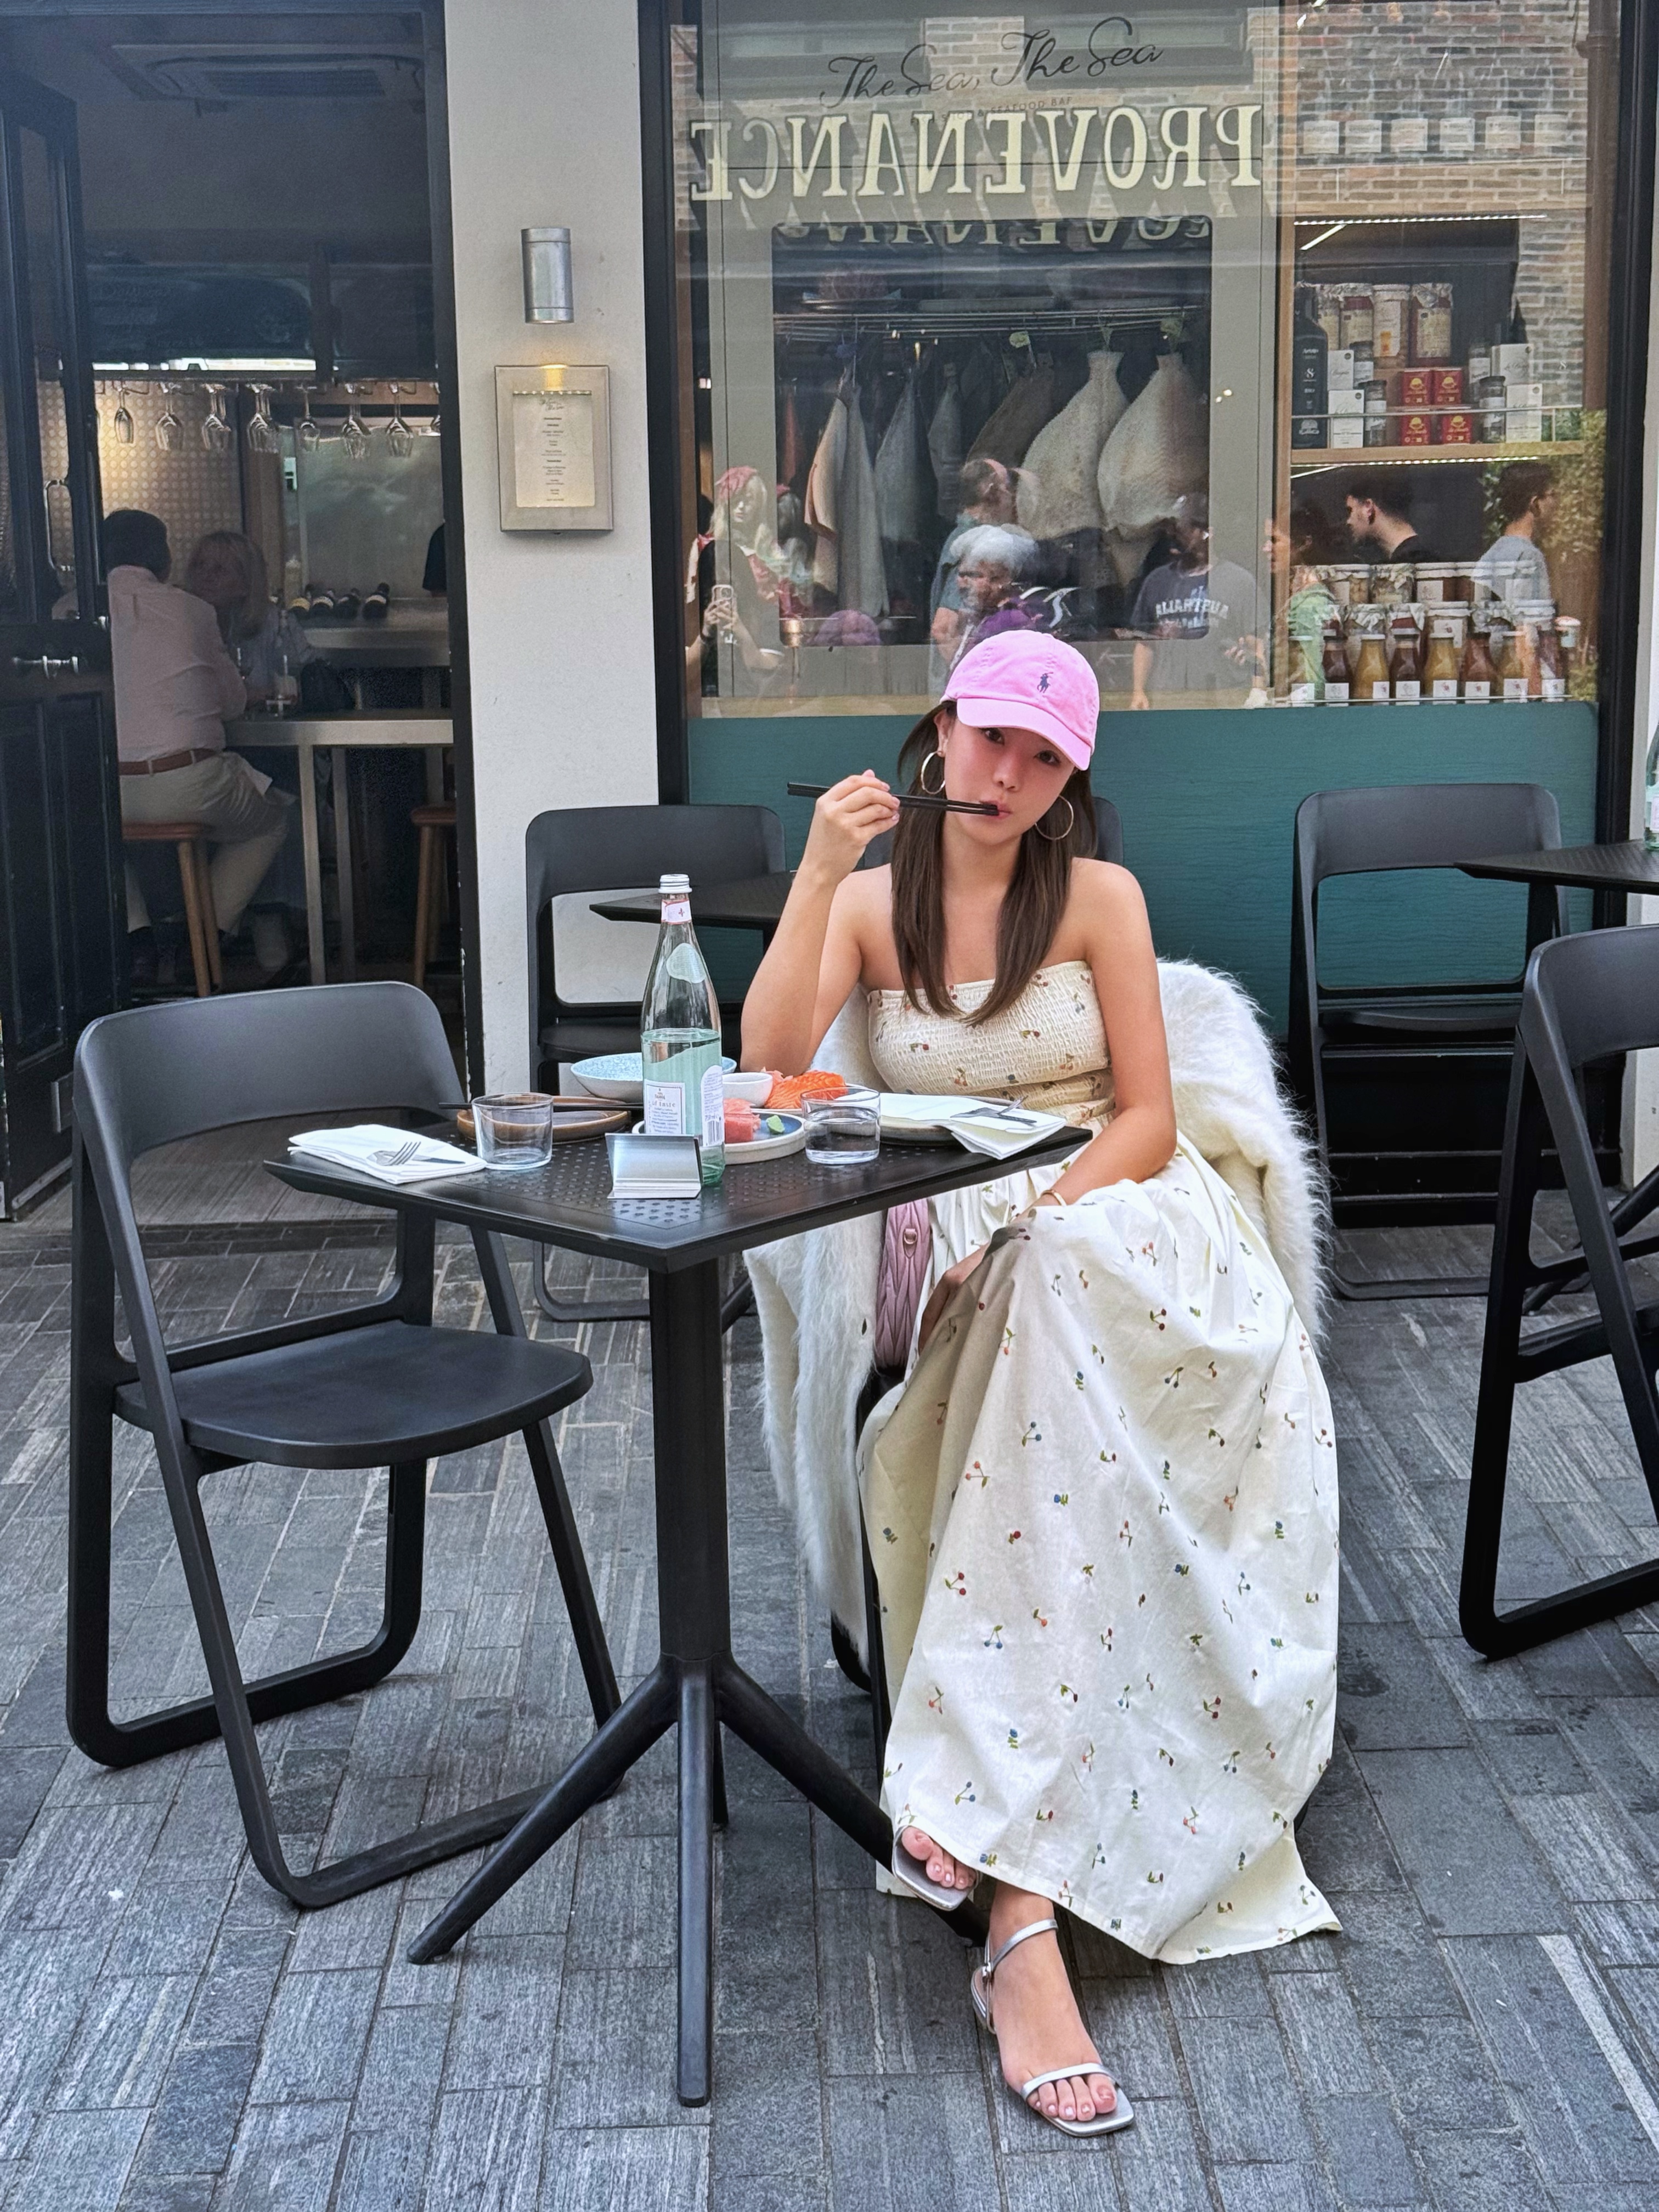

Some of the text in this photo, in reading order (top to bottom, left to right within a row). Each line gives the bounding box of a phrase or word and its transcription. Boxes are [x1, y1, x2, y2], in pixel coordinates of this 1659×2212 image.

[819, 56, 896, 109] The
[991, 29, 1080, 87] The
[1087, 16, 1164, 77] Sea
